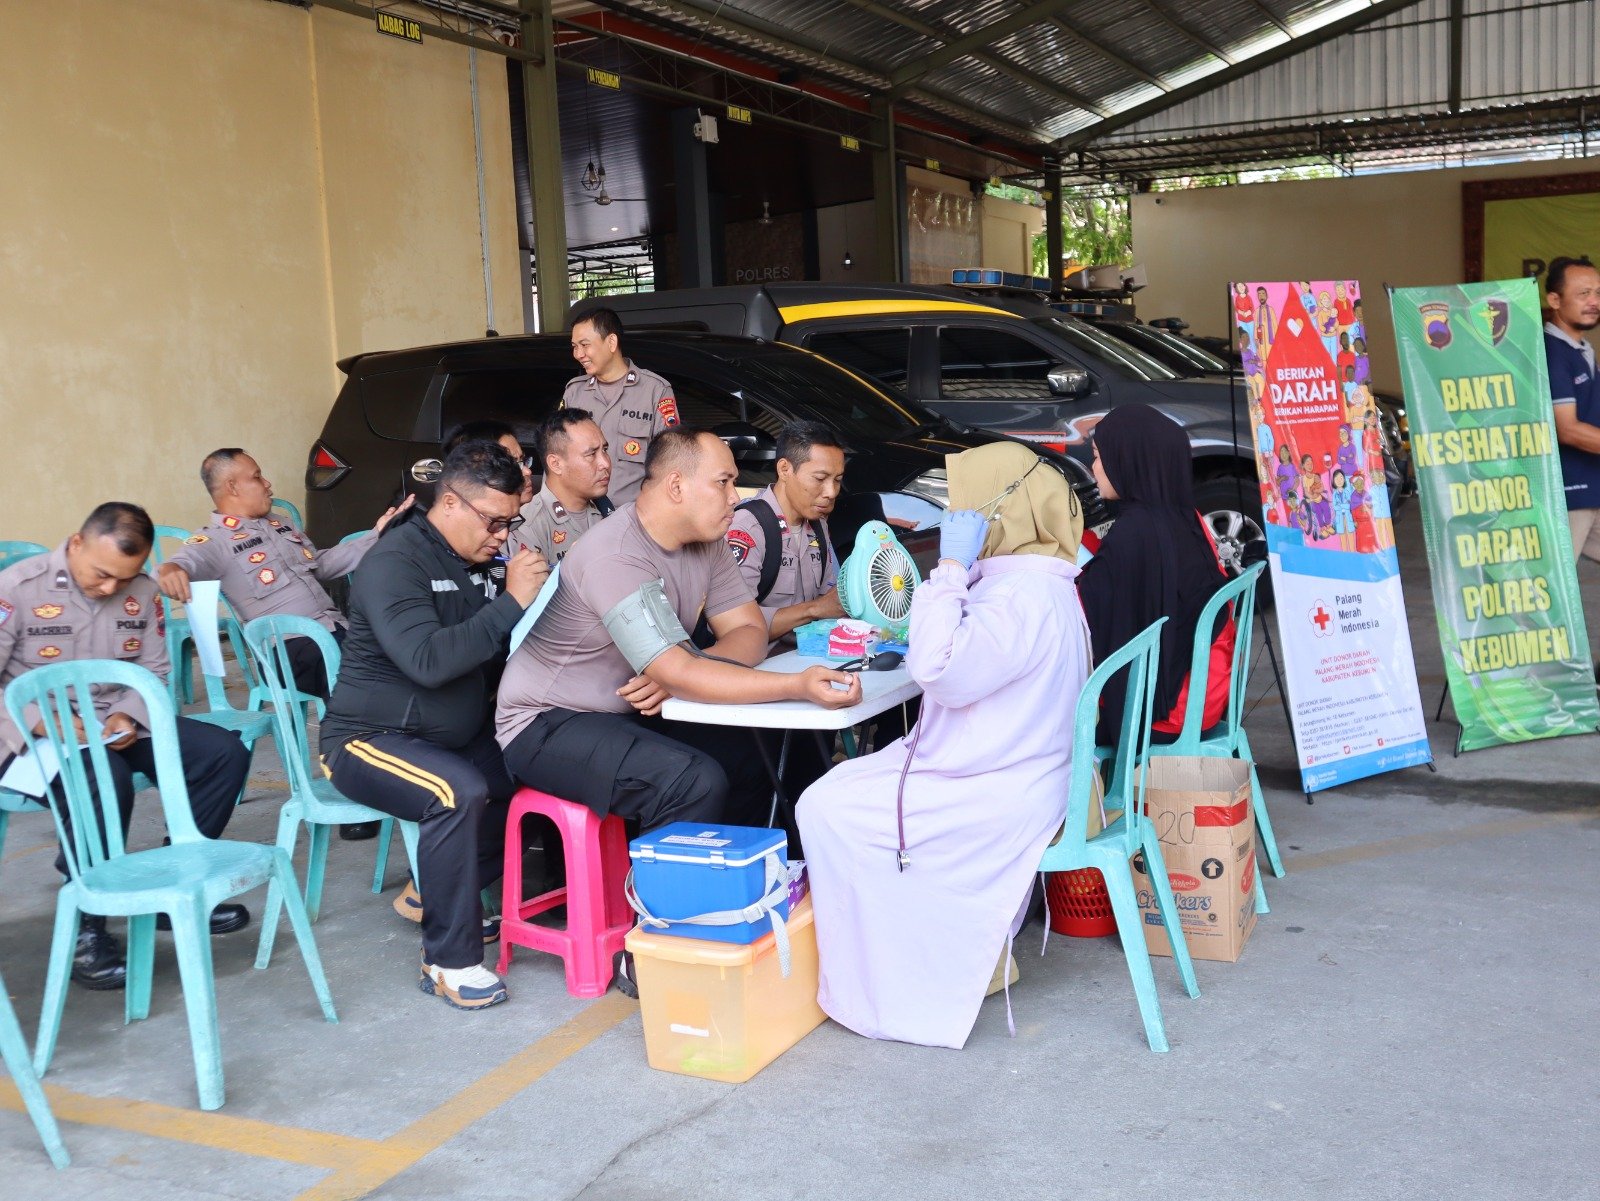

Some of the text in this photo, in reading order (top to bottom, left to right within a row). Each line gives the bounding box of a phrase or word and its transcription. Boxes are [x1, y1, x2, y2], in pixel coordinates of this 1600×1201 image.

[378, 13, 420, 40] KABAG LOG
[736, 266, 790, 281] POLRES
[1276, 366, 1324, 381] BERIKAN
[1270, 379, 1337, 404] DARAH
[1440, 373, 1516, 412] BAKTI
[622, 409, 653, 421] POLRI
[1274, 403, 1339, 416] BERIKAN HARAPAN
[1413, 421, 1553, 468] KESEHATAN
[1449, 475, 1532, 516] DONOR
[1456, 525, 1542, 568] DARAH
[1335, 594, 1362, 606] Palang
[1462, 576, 1552, 621] POLRES
[1338, 607, 1362, 620] Merah
[1341, 619, 1380, 634] Indonesia
[1460, 626, 1571, 675] KEBUMEN
[1158, 811, 1195, 845] 20
[1136, 890, 1211, 911] Crkers
